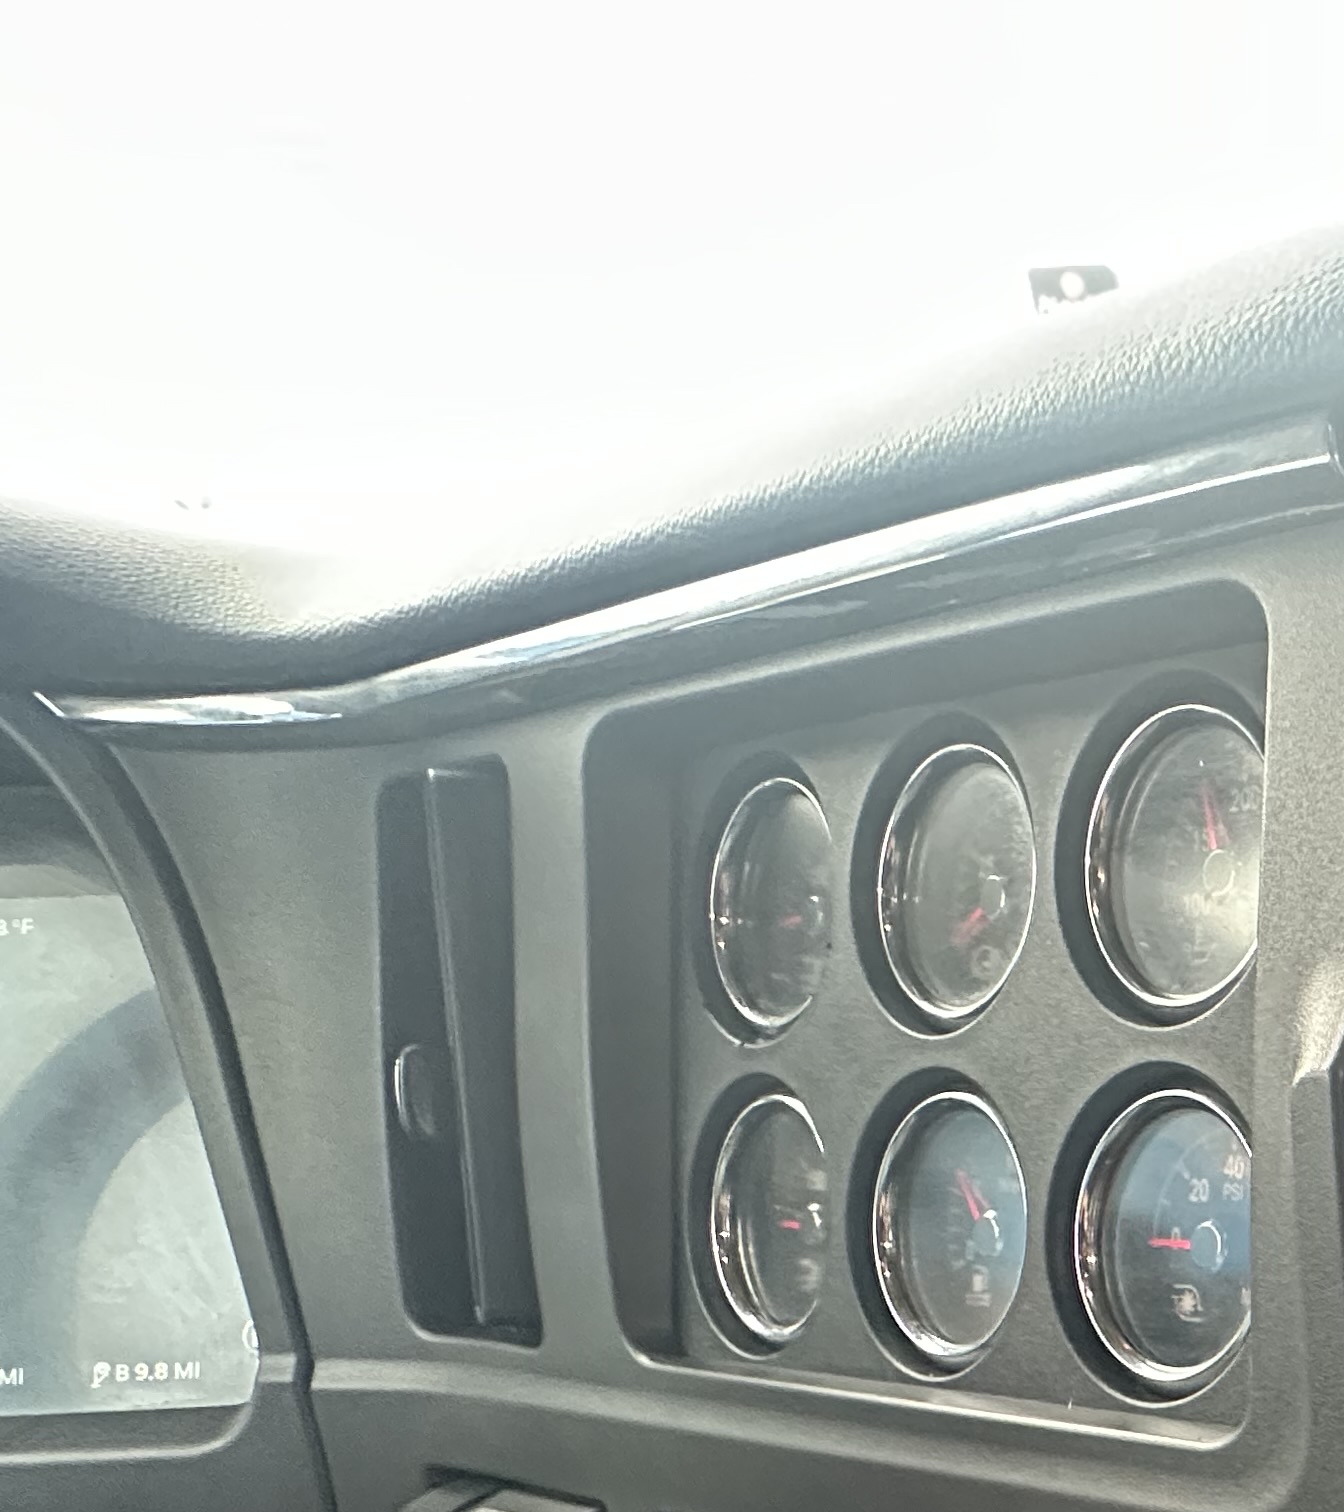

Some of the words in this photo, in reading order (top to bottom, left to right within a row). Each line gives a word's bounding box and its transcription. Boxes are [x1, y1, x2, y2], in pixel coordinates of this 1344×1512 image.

[1189, 1178, 1210, 1203] 20
[134, 1362, 169, 1382] 9.8
[174, 1361, 201, 1380] MI
